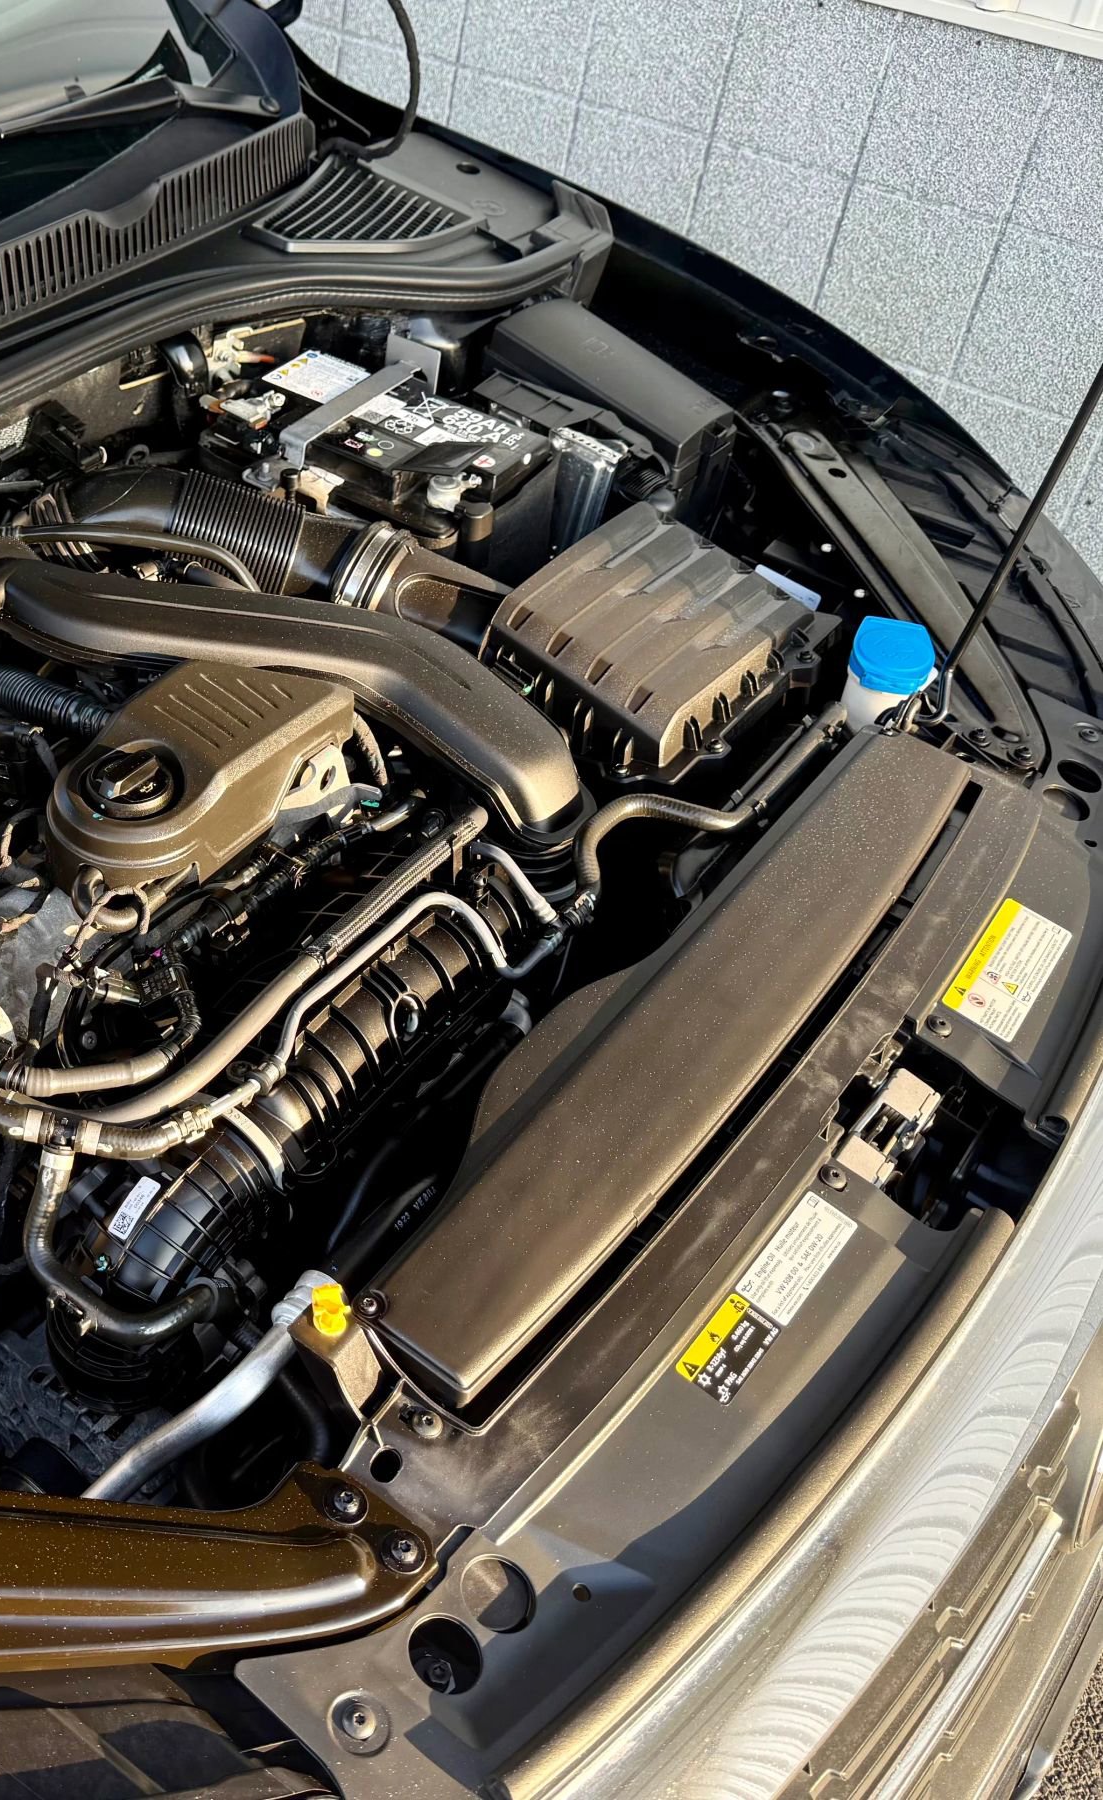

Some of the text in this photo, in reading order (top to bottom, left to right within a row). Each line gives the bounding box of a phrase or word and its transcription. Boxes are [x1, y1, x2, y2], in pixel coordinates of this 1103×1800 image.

[442, 414, 484, 434] 640
[454, 408, 511, 435] 59Ah
[774, 1221, 799, 1251] Huile moteur
[755, 1253, 774, 1278] Engine Oil
[776, 1283, 785, 1294] VW
[783, 1274, 792, 1284] 508
[790, 1266, 798, 1274] 00
[801, 1250, 810, 1260] SAE
[763, 1327, 778, 1345] VW AG
[724, 1371, 737, 1386] PAG
